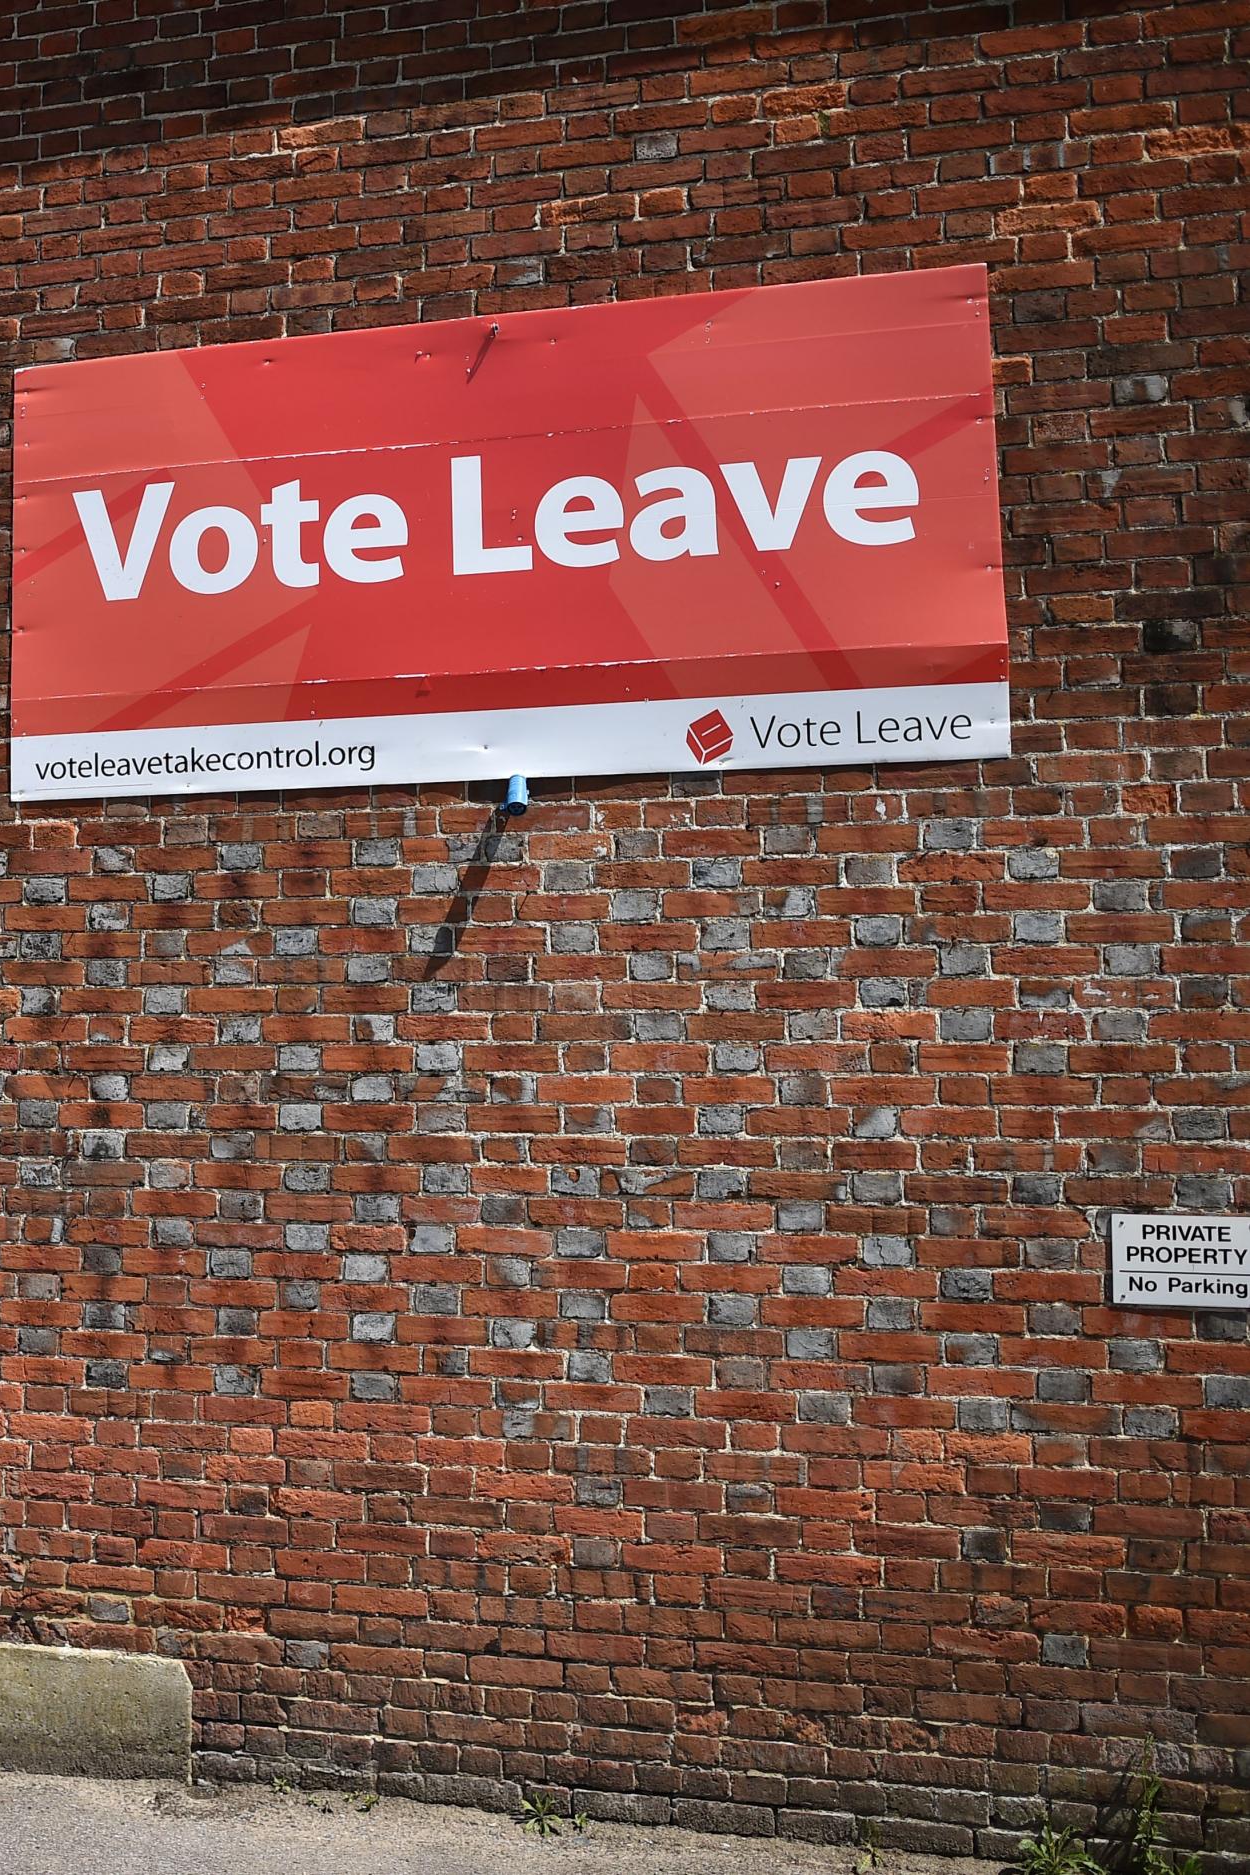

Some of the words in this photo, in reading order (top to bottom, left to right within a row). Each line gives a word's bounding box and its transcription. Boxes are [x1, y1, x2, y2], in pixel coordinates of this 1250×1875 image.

[72, 479, 408, 601] Vote
[450, 450, 919, 576] Leave
[750, 715, 841, 749] Vote
[856, 710, 972, 744] Leave
[35, 740, 376, 780] voteleavetakecontrol.org
[1142, 1224, 1232, 1243] PRIVATE
[1126, 1246, 1248, 1265] PROPERTY
[1129, 1276, 1157, 1293] No
[1168, 1277, 1248, 1299] Parking
